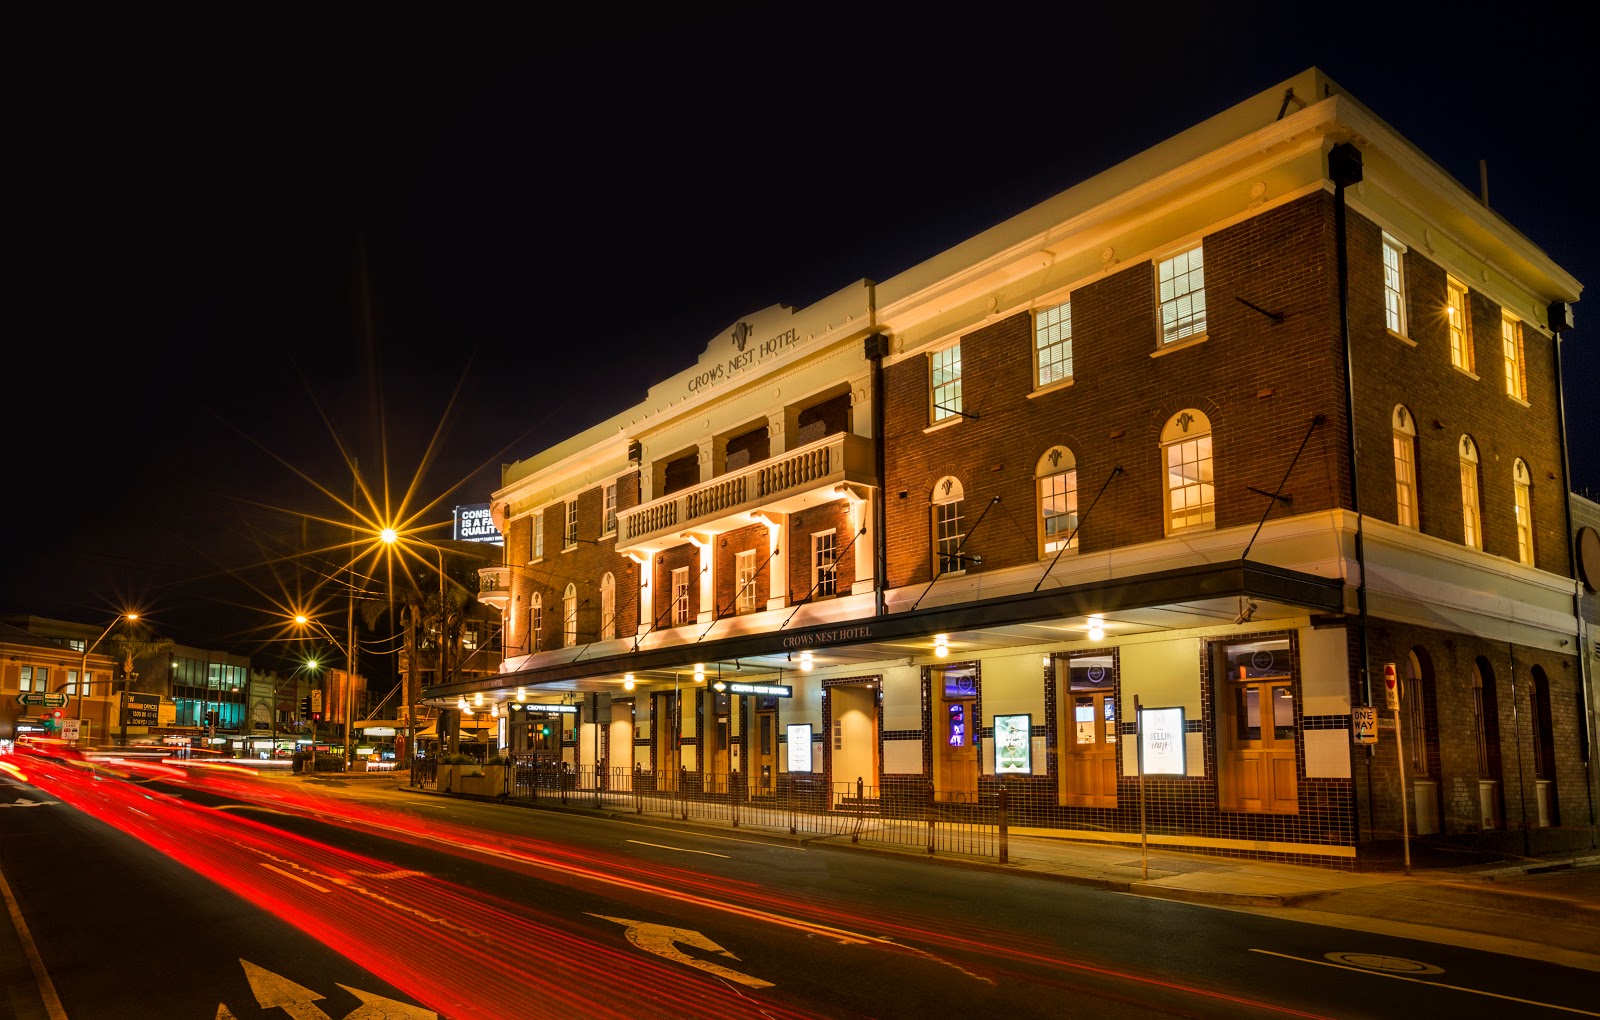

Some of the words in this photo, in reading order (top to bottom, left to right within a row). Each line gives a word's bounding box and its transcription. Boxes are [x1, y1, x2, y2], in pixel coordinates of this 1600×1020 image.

[688, 363, 724, 392] CROWS
[728, 348, 755, 373] NEST
[760, 327, 800, 358] HOTEL
[462, 519, 472, 528] IS
[473, 518, 481, 527] A
[461, 525, 502, 537] QUALIT
[783, 634, 814, 647] CROWS
[815, 630, 838, 643] NEST
[840, 626, 872, 641] HOTEL
[560, 705, 577, 713] HOTEL
[1354, 711, 1374, 720] ONE
[1354, 721, 1375, 730] WAY
